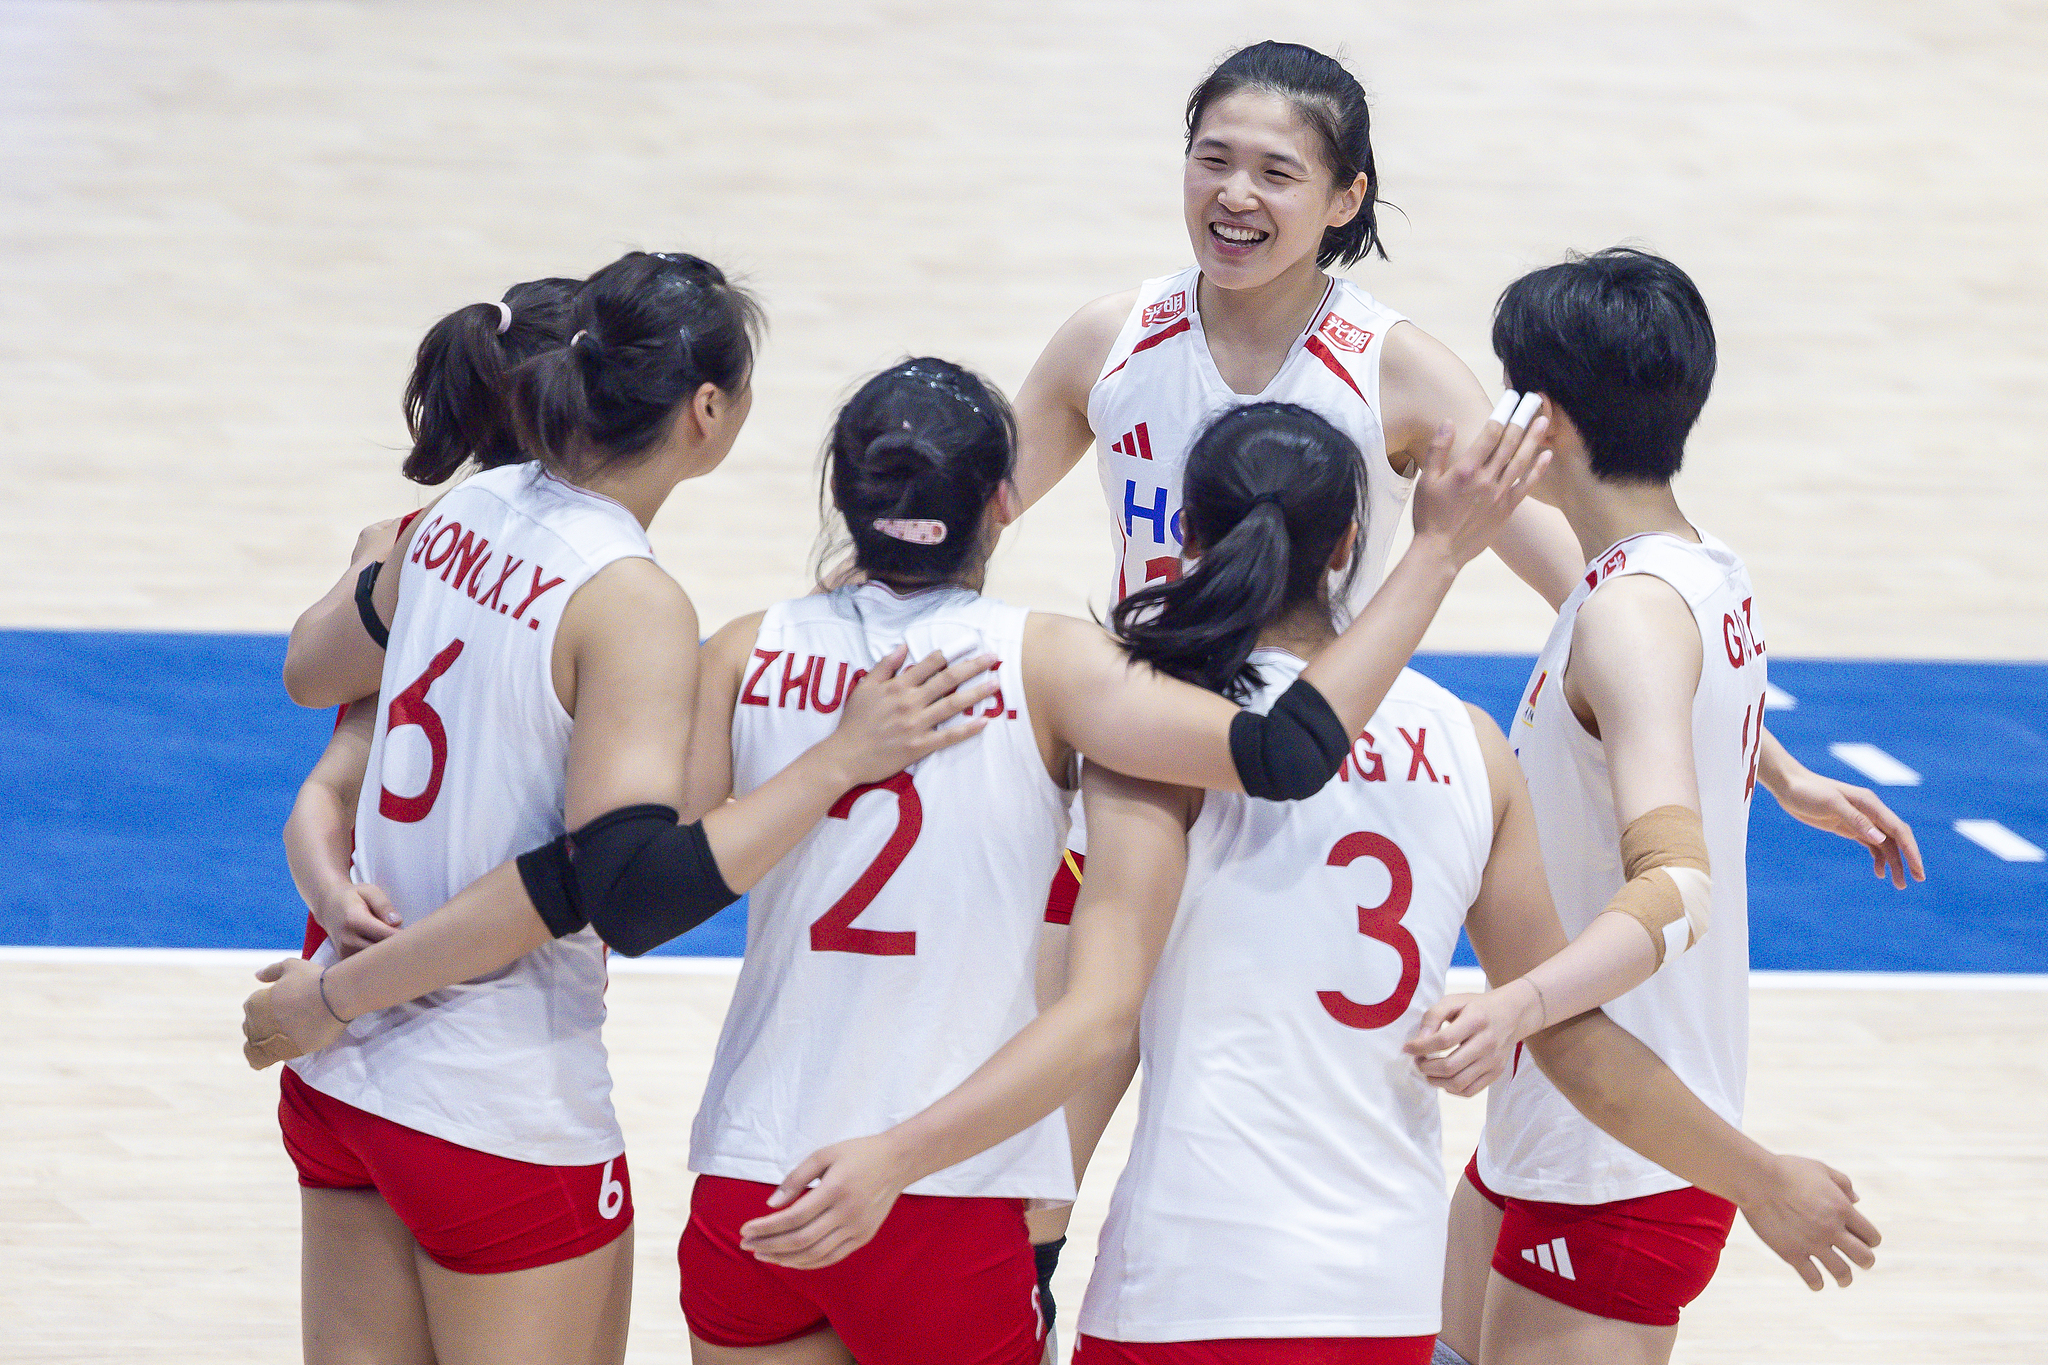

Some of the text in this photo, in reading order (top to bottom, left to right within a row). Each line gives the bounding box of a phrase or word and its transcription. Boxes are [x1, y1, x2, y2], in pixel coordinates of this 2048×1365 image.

[1143, 291, 1186, 326] 光明
[1320, 313, 1373, 353] 光明
[379, 638, 465, 823] 6
[1397, 727, 1451, 785] X.
[810, 770, 923, 956] 2
[1316, 831, 1421, 1030] 3
[598, 1159, 624, 1220] 6
